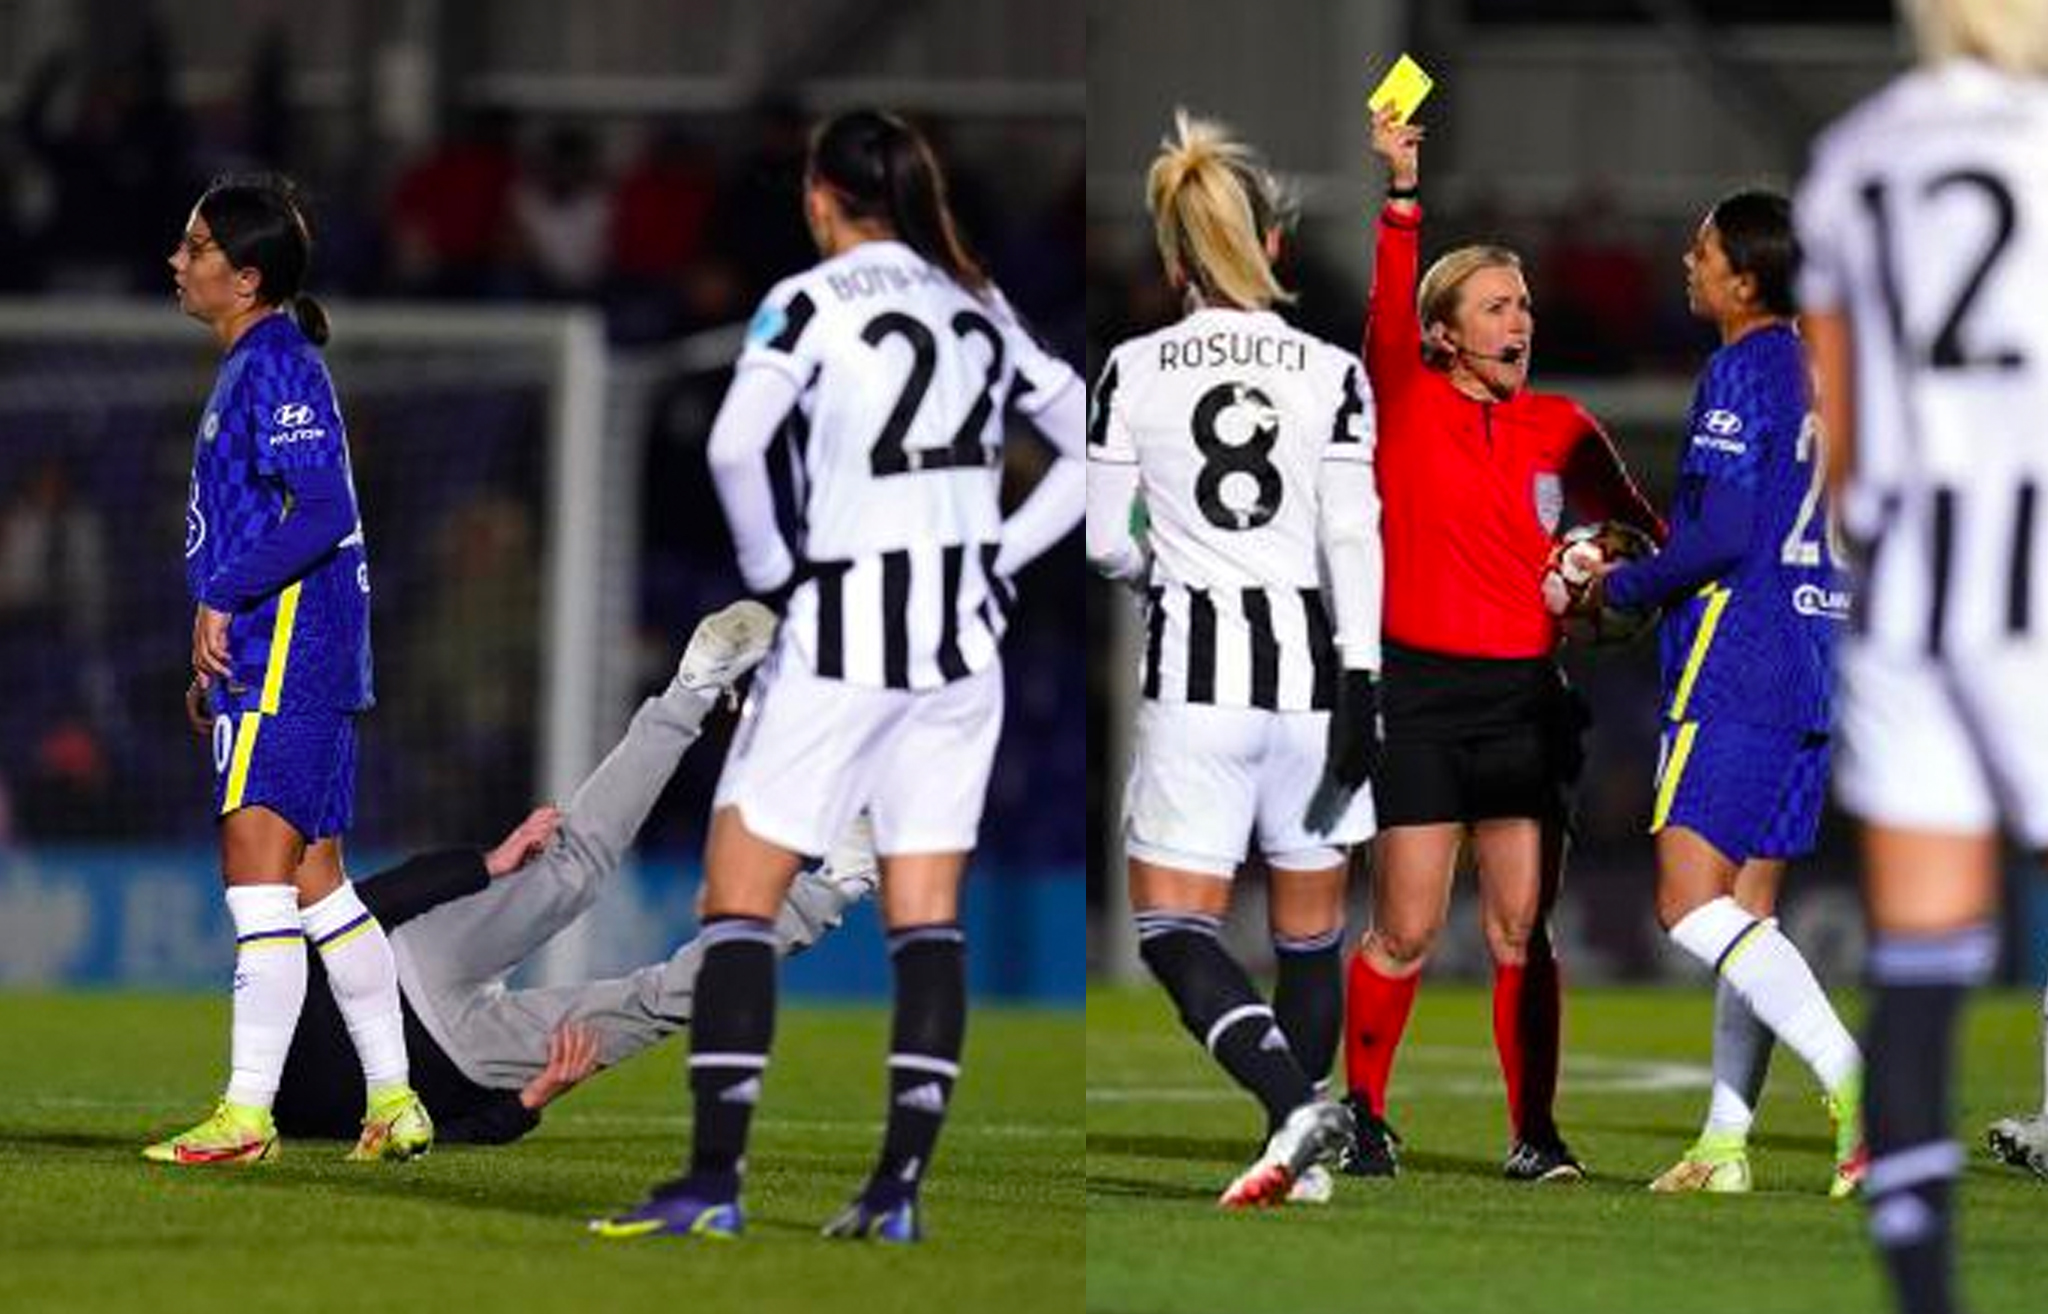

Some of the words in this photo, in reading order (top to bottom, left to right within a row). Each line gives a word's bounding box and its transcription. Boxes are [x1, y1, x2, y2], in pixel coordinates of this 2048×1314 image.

[1856, 170, 2024, 370] 12
[860, 310, 1004, 477] 22
[1159, 332, 1306, 371] ROSUCCI
[1190, 380, 1284, 532] 8
